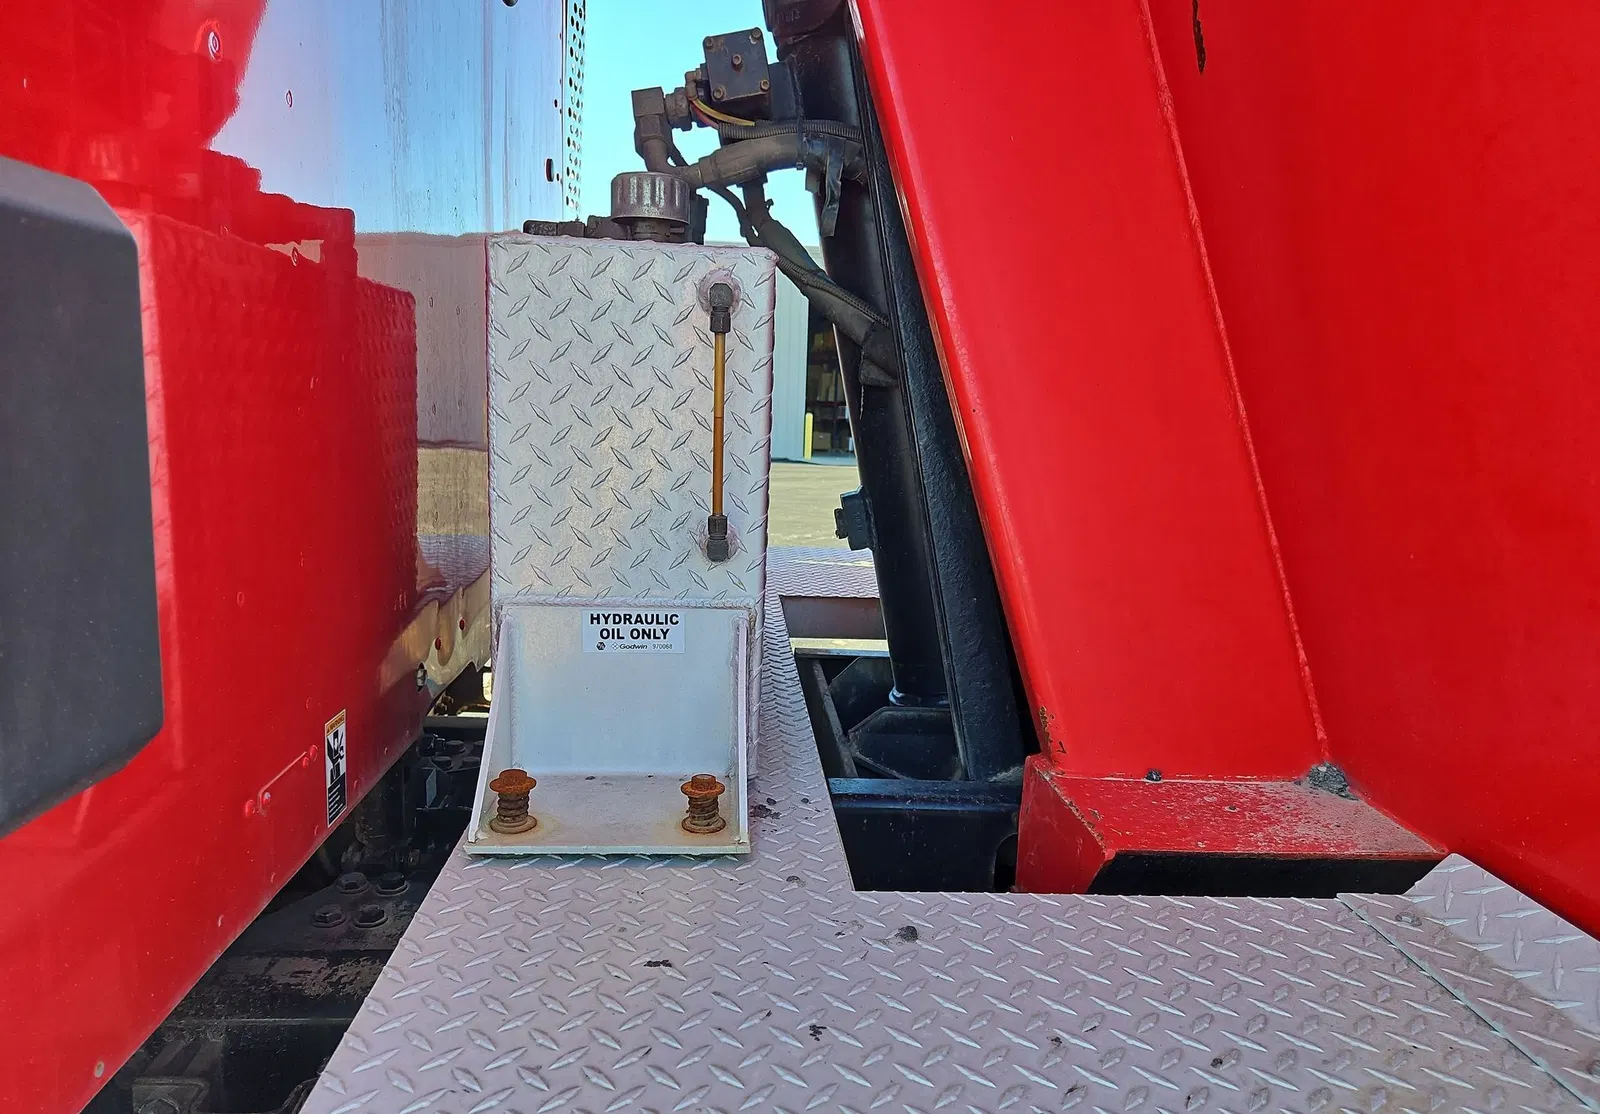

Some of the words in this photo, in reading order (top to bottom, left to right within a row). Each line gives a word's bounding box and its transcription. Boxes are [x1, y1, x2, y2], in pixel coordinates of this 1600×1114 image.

[590, 613, 679, 625] HYDRAULIC
[599, 628, 625, 640] OIL
[630, 628, 670, 640] ONLY
